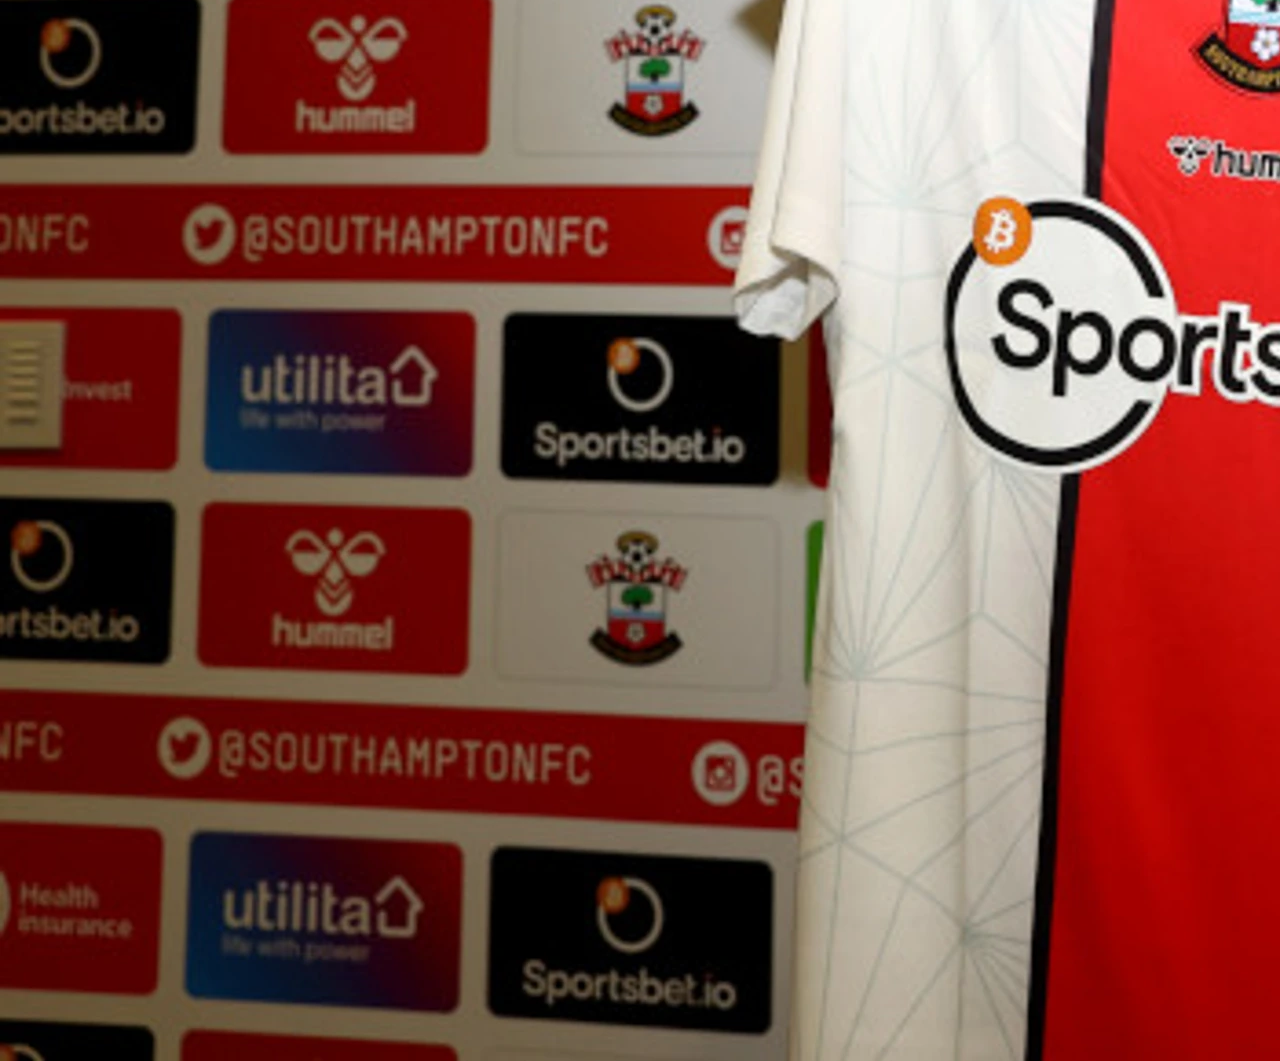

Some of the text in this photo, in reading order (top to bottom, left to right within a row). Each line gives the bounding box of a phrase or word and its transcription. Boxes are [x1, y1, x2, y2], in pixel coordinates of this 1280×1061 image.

[296, 94, 415, 132] hummel
[245, 216, 608, 261] @SOUTHAMPTONFC
[241, 354, 386, 405] utilita
[535, 422, 744, 466] Sportsbet.io
[273, 612, 393, 649] hummel
[220, 732, 591, 785] @SOUTHAMPTONFC
[20, 882, 99, 908] Health
[223, 880, 370, 935] utilita
[523, 959, 736, 1009] Sportsbet.io
